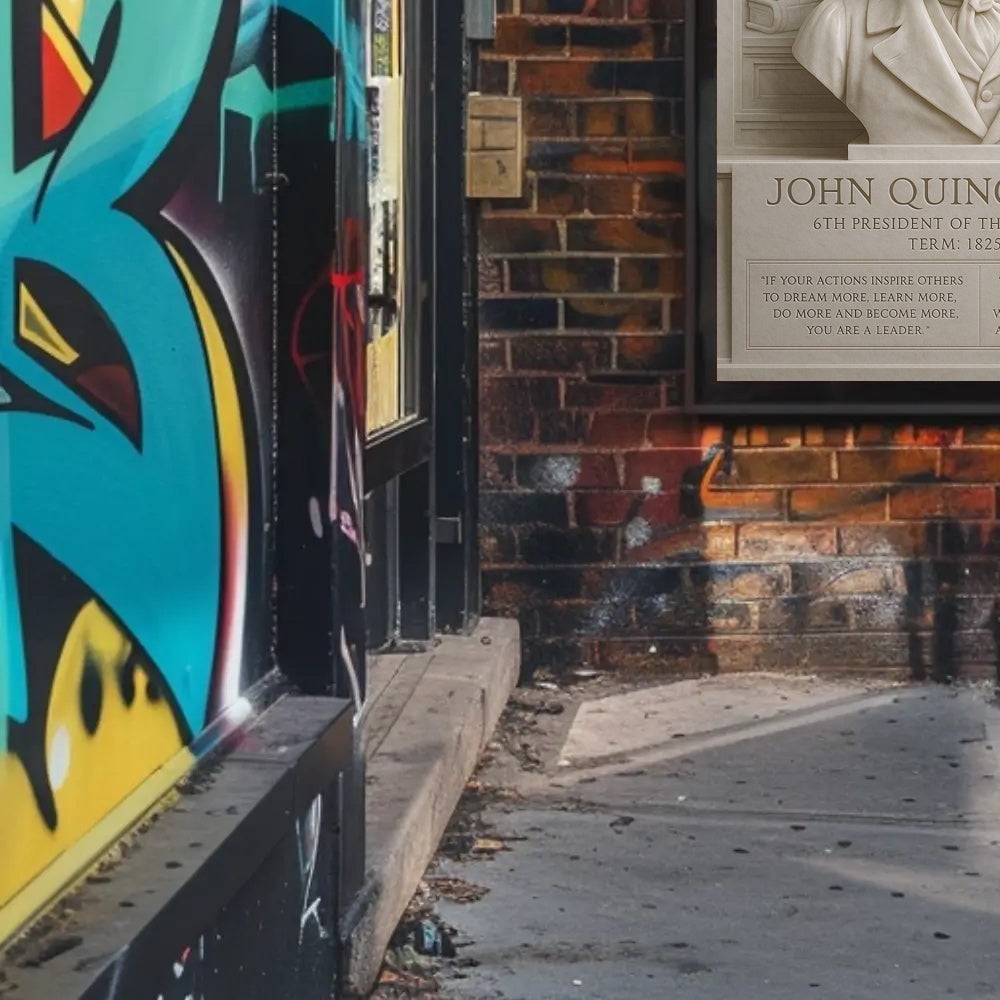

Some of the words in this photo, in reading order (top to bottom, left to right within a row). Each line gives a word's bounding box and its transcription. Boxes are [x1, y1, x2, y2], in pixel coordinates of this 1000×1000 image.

[766, 177, 875, 206] JOHN
[813, 217, 846, 230] 6TH
[852, 217, 943, 230] PRESIDENT
[950, 217, 972, 230] OF
[907, 237, 961, 251] TERM:
[780, 275, 814, 286] YOUR
[817, 275, 868, 286] ACTIONS
[871, 275, 914, 286] INSPIRE
[917, 275, 964, 286] OTHERS
[763, 292, 780, 303] TO
[783, 292, 827, 303] DREAM
[832, 292, 870, 303] MORE,
[873, 292, 914, 303] LEARN
[918, 292, 957, 304] MORE,
[773, 308, 792, 319] DO
[795, 308, 832, 319] MORE
[835, 308, 863, 319] AND
[866, 308, 917, 319] BECOME
[920, 308, 959, 320] MORE,
[806, 325, 832, 336] YOU
[836, 325, 860, 336] ARE
[863, 325, 871, 336] A
